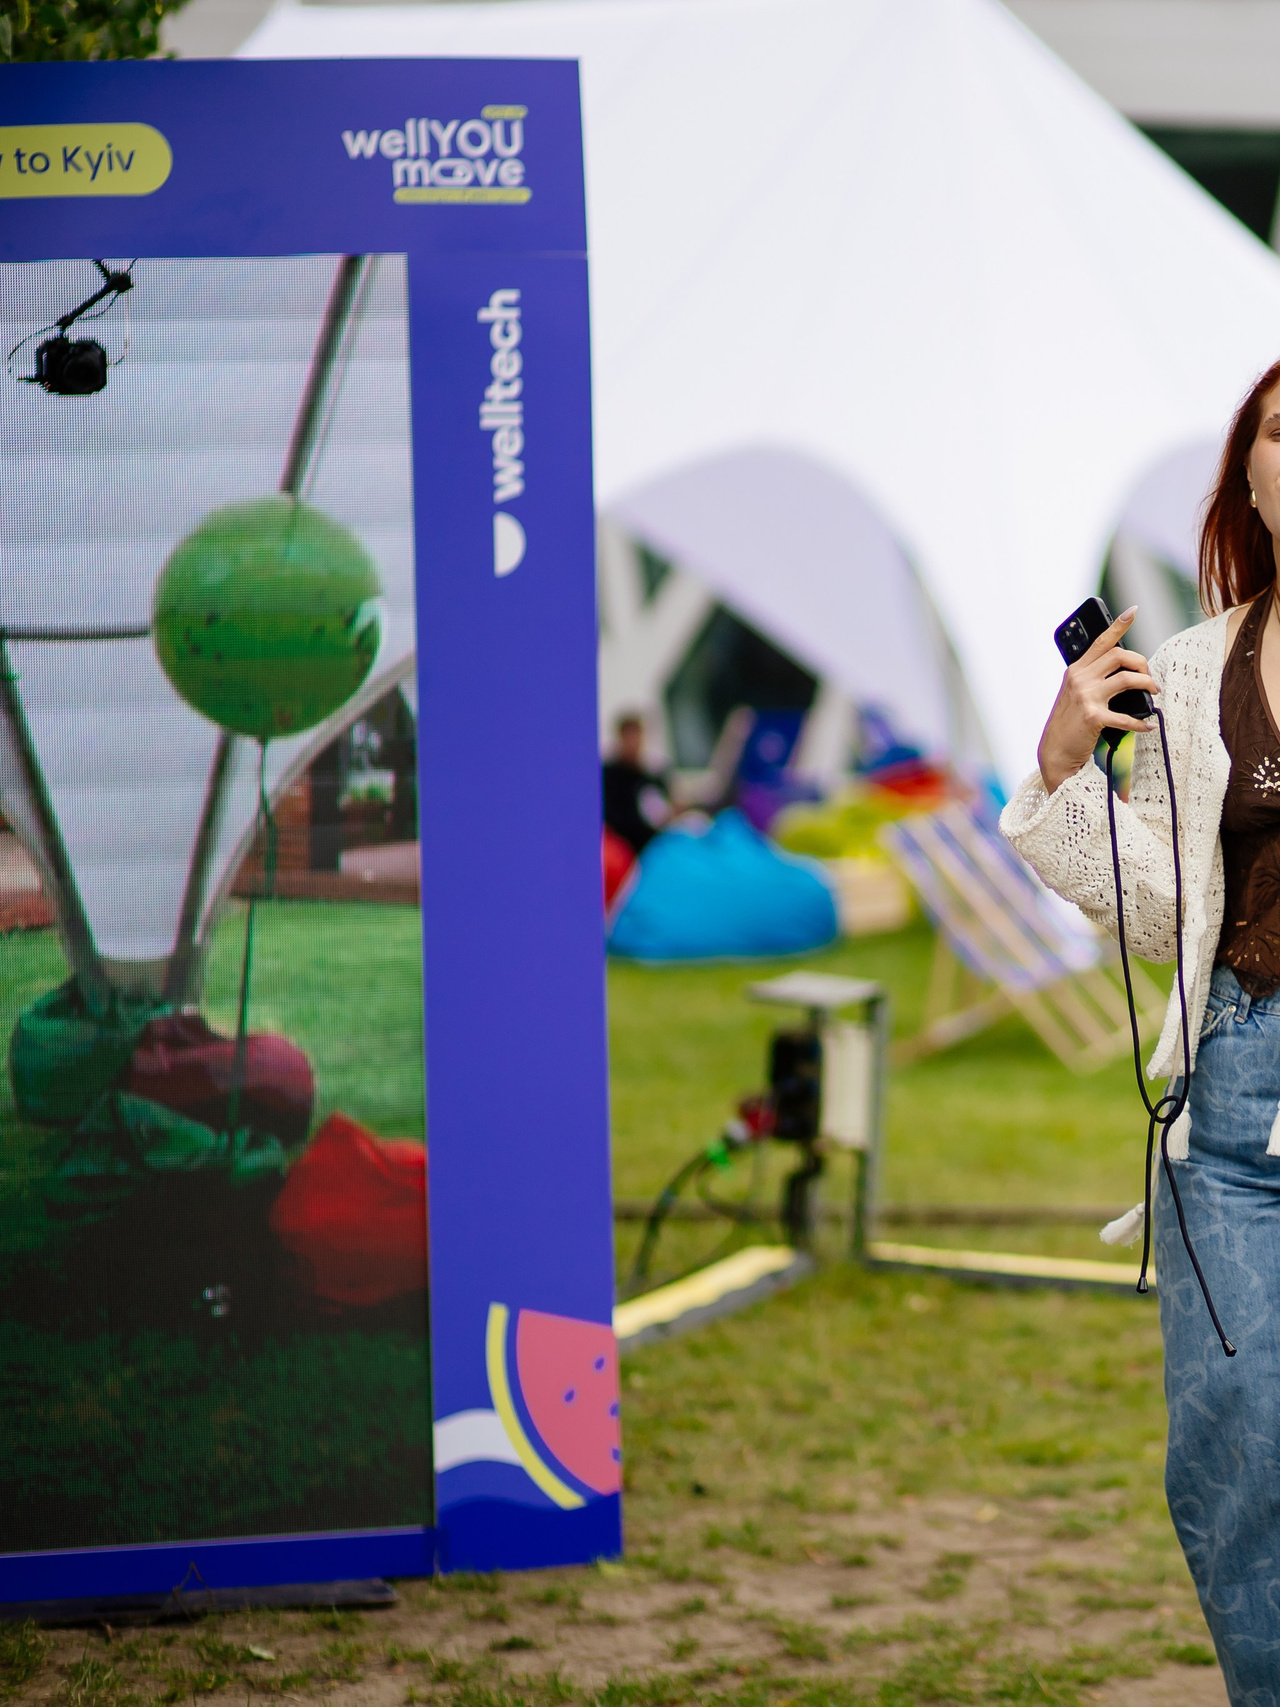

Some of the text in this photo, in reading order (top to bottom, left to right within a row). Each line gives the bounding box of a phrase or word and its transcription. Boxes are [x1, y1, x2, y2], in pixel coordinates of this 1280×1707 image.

[14, 148, 50, 174] to
[62, 143, 136, 182] Kyiv
[392, 157, 526, 188] move
[477, 288, 525, 504] welltech
